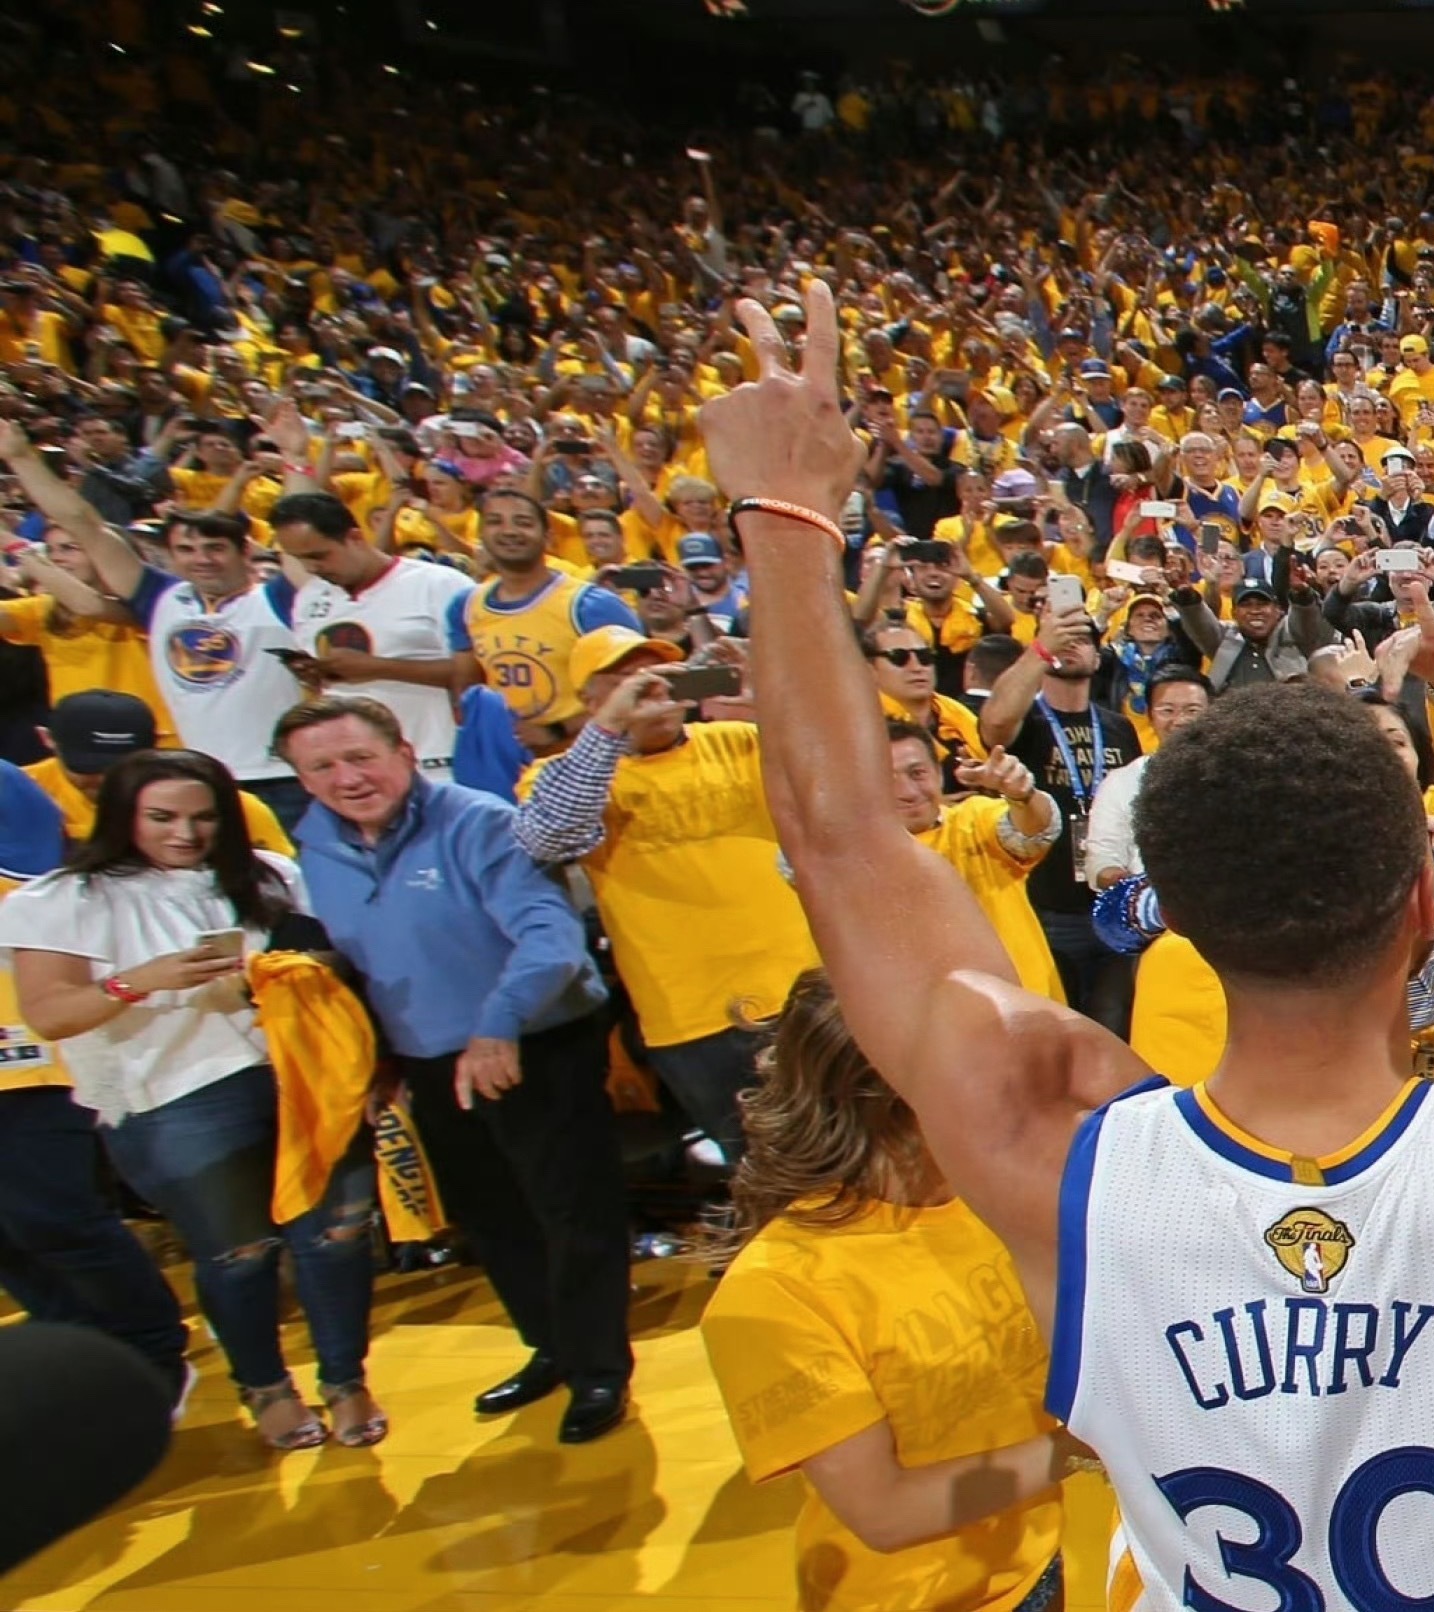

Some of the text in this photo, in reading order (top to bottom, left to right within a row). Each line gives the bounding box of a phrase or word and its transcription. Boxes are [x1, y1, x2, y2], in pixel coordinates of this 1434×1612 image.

[474, 635, 553, 657] CITY
[494, 663, 531, 686] 30
[1052, 747, 1123, 765] AAIST
[1293, 1220, 1349, 1244] Finals
